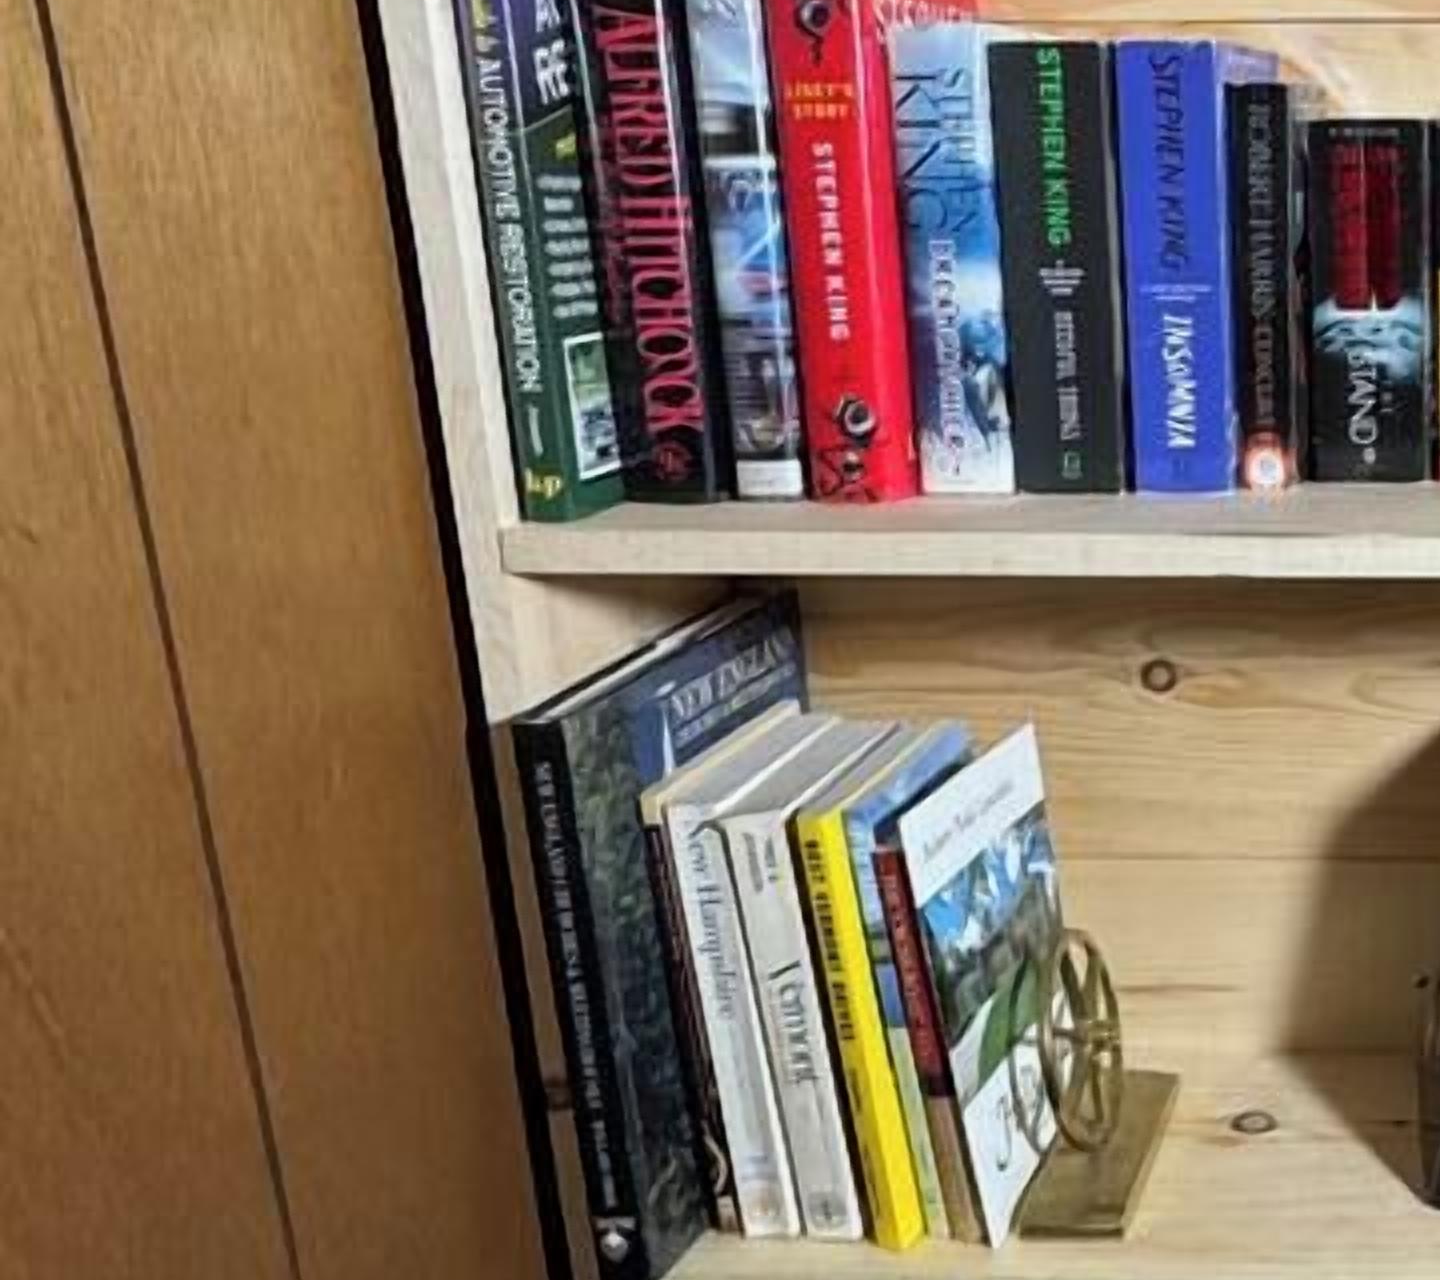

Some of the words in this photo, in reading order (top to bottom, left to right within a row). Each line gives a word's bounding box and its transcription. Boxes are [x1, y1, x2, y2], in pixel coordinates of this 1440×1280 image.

[477, 57, 519, 218] AUTOMOTIVE
[595, 5, 674, 186] ALFRED
[894, 75, 947, 233] KING
[946, 70, 980, 233] STEPHEN
[1035, 46, 1069, 172] STEPHEN
[1147, 54, 1187, 186] STEPHEN
[811, 142, 847, 264] STEPHEN
[1046, 177, 1073, 246] KING
[1157, 194, 1192, 271] KING
[497, 224, 543, 393] RESTORATION
[821, 276, 850, 341] KING
[1161, 312, 1197, 449] INSOMNIA
[1348, 350, 1378, 446] STAND
[696, 881, 740, 1022] Hampshire
[768, 959, 820, 1084] Vermont
